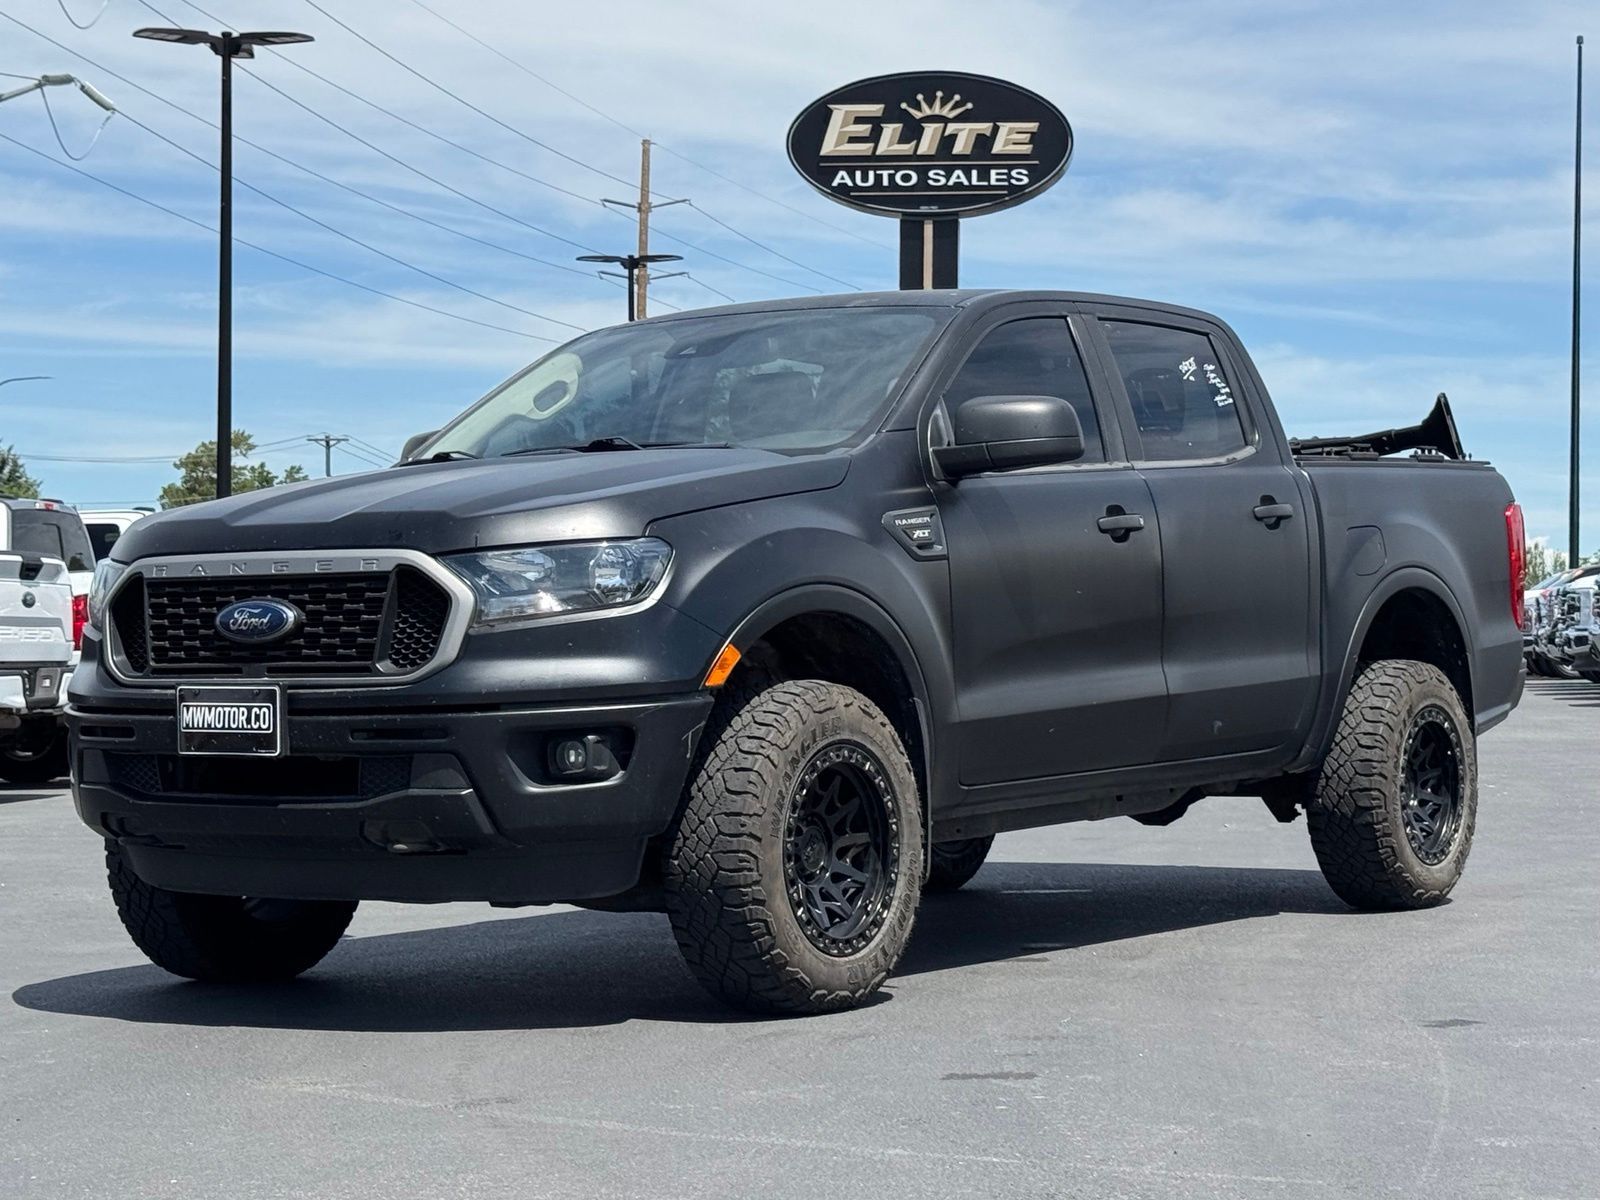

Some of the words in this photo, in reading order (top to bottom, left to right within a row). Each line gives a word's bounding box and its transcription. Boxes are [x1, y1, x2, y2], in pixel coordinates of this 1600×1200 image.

[819, 103, 1040, 156] ELITE
[831, 169, 918, 187] AUTO
[927, 168, 1030, 186] SALES
[894, 516, 931, 526] RANGER
[912, 529, 931, 539] XLT
[152, 558, 379, 577] RANGER
[229, 607, 272, 632] Ford
[183, 706, 269, 729] MWMOTOR.CO
